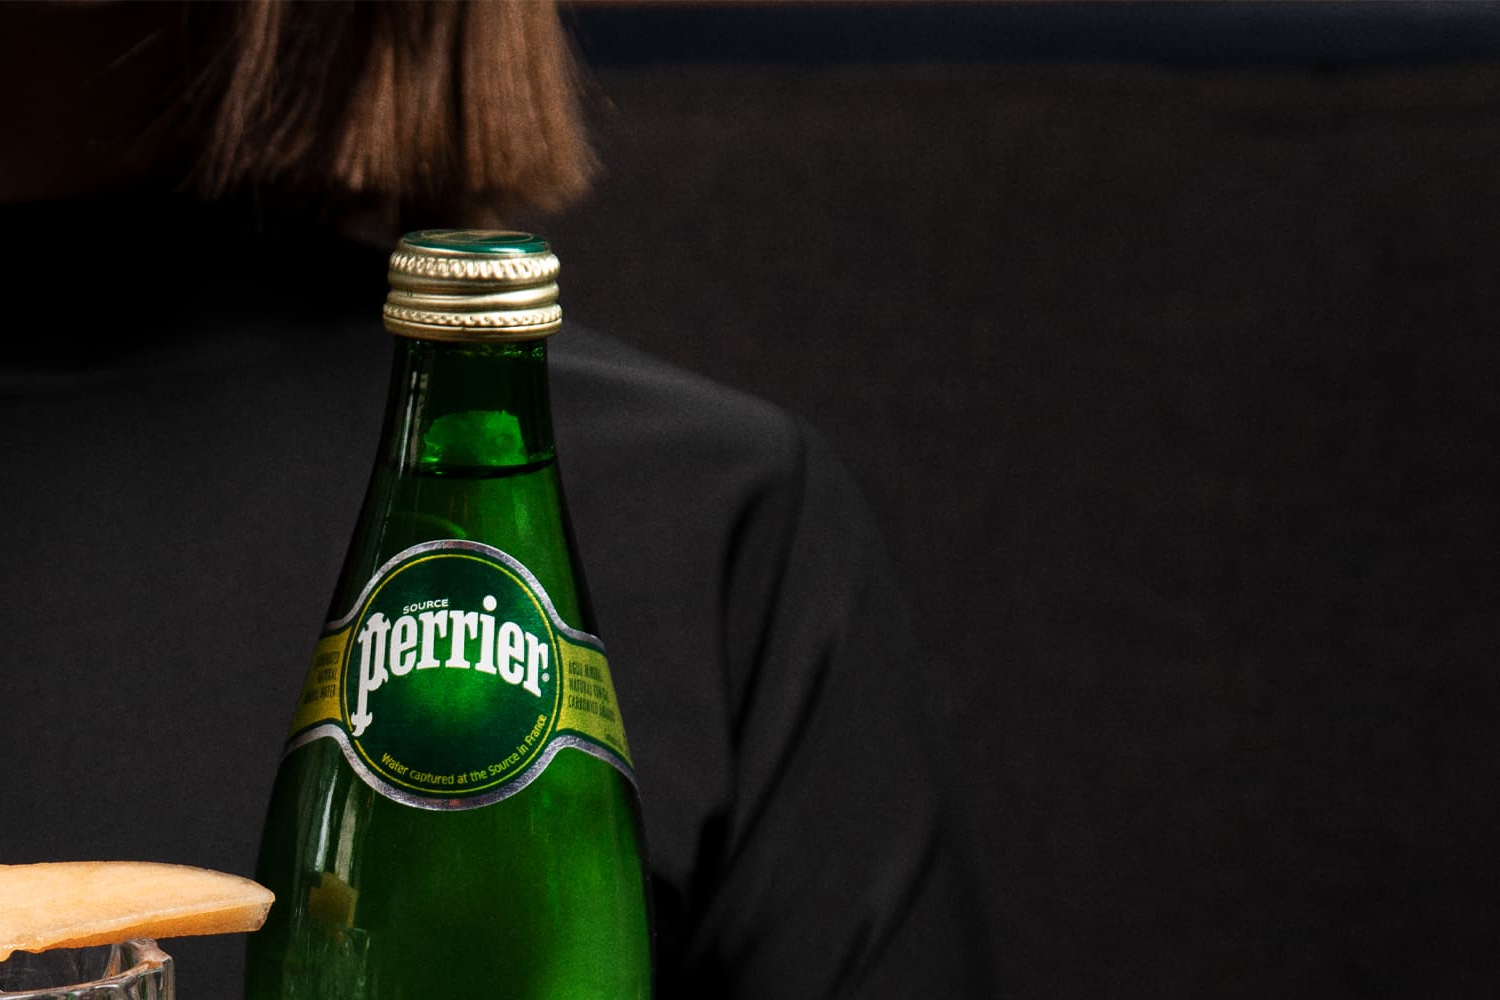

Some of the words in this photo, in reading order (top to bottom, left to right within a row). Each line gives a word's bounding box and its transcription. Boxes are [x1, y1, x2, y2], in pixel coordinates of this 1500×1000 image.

[403, 599, 448, 614] SOURCE
[381, 753, 408, 775] Water
[409, 769, 455, 785] captured
[457, 773, 469, 784] at
[470, 769, 488, 783] the
[488, 753, 520, 776] Source
[516, 744, 529, 756] in
[524, 714, 547, 747] France
